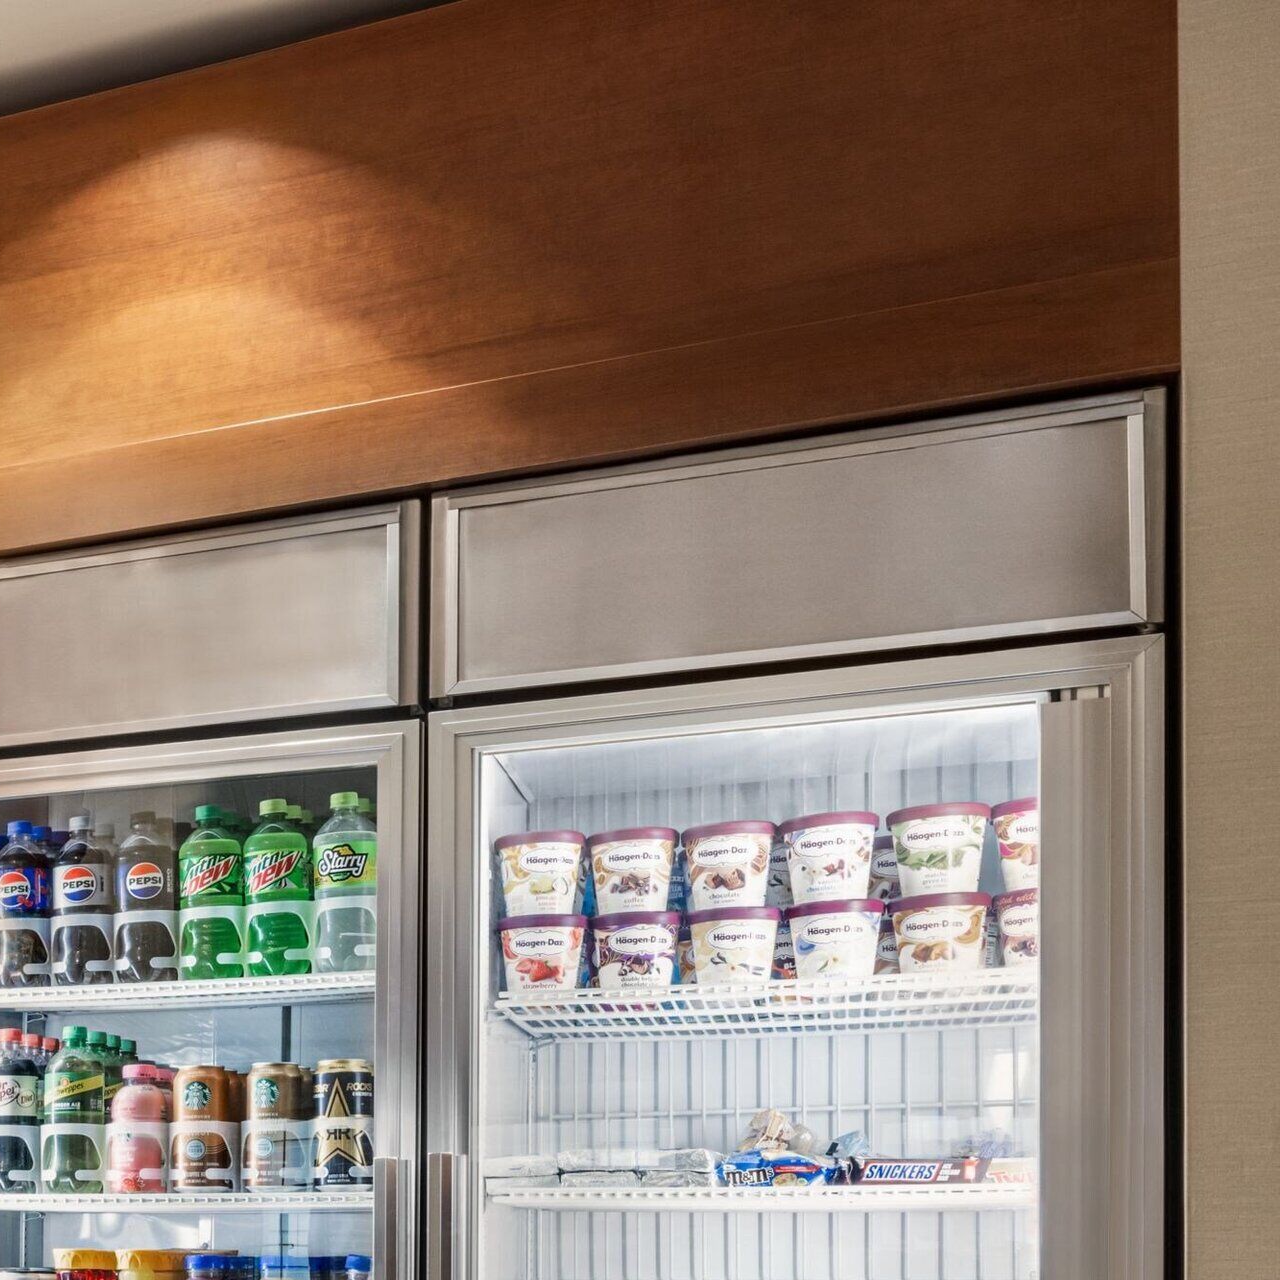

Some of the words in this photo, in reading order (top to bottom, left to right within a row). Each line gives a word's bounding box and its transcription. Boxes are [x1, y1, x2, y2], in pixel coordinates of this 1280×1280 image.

[319, 849, 368, 878] Starry
[62, 880, 95, 890] PEPSI
[128, 877, 162, 887] PEPSI
[864, 1163, 937, 1181] SNICKERS
